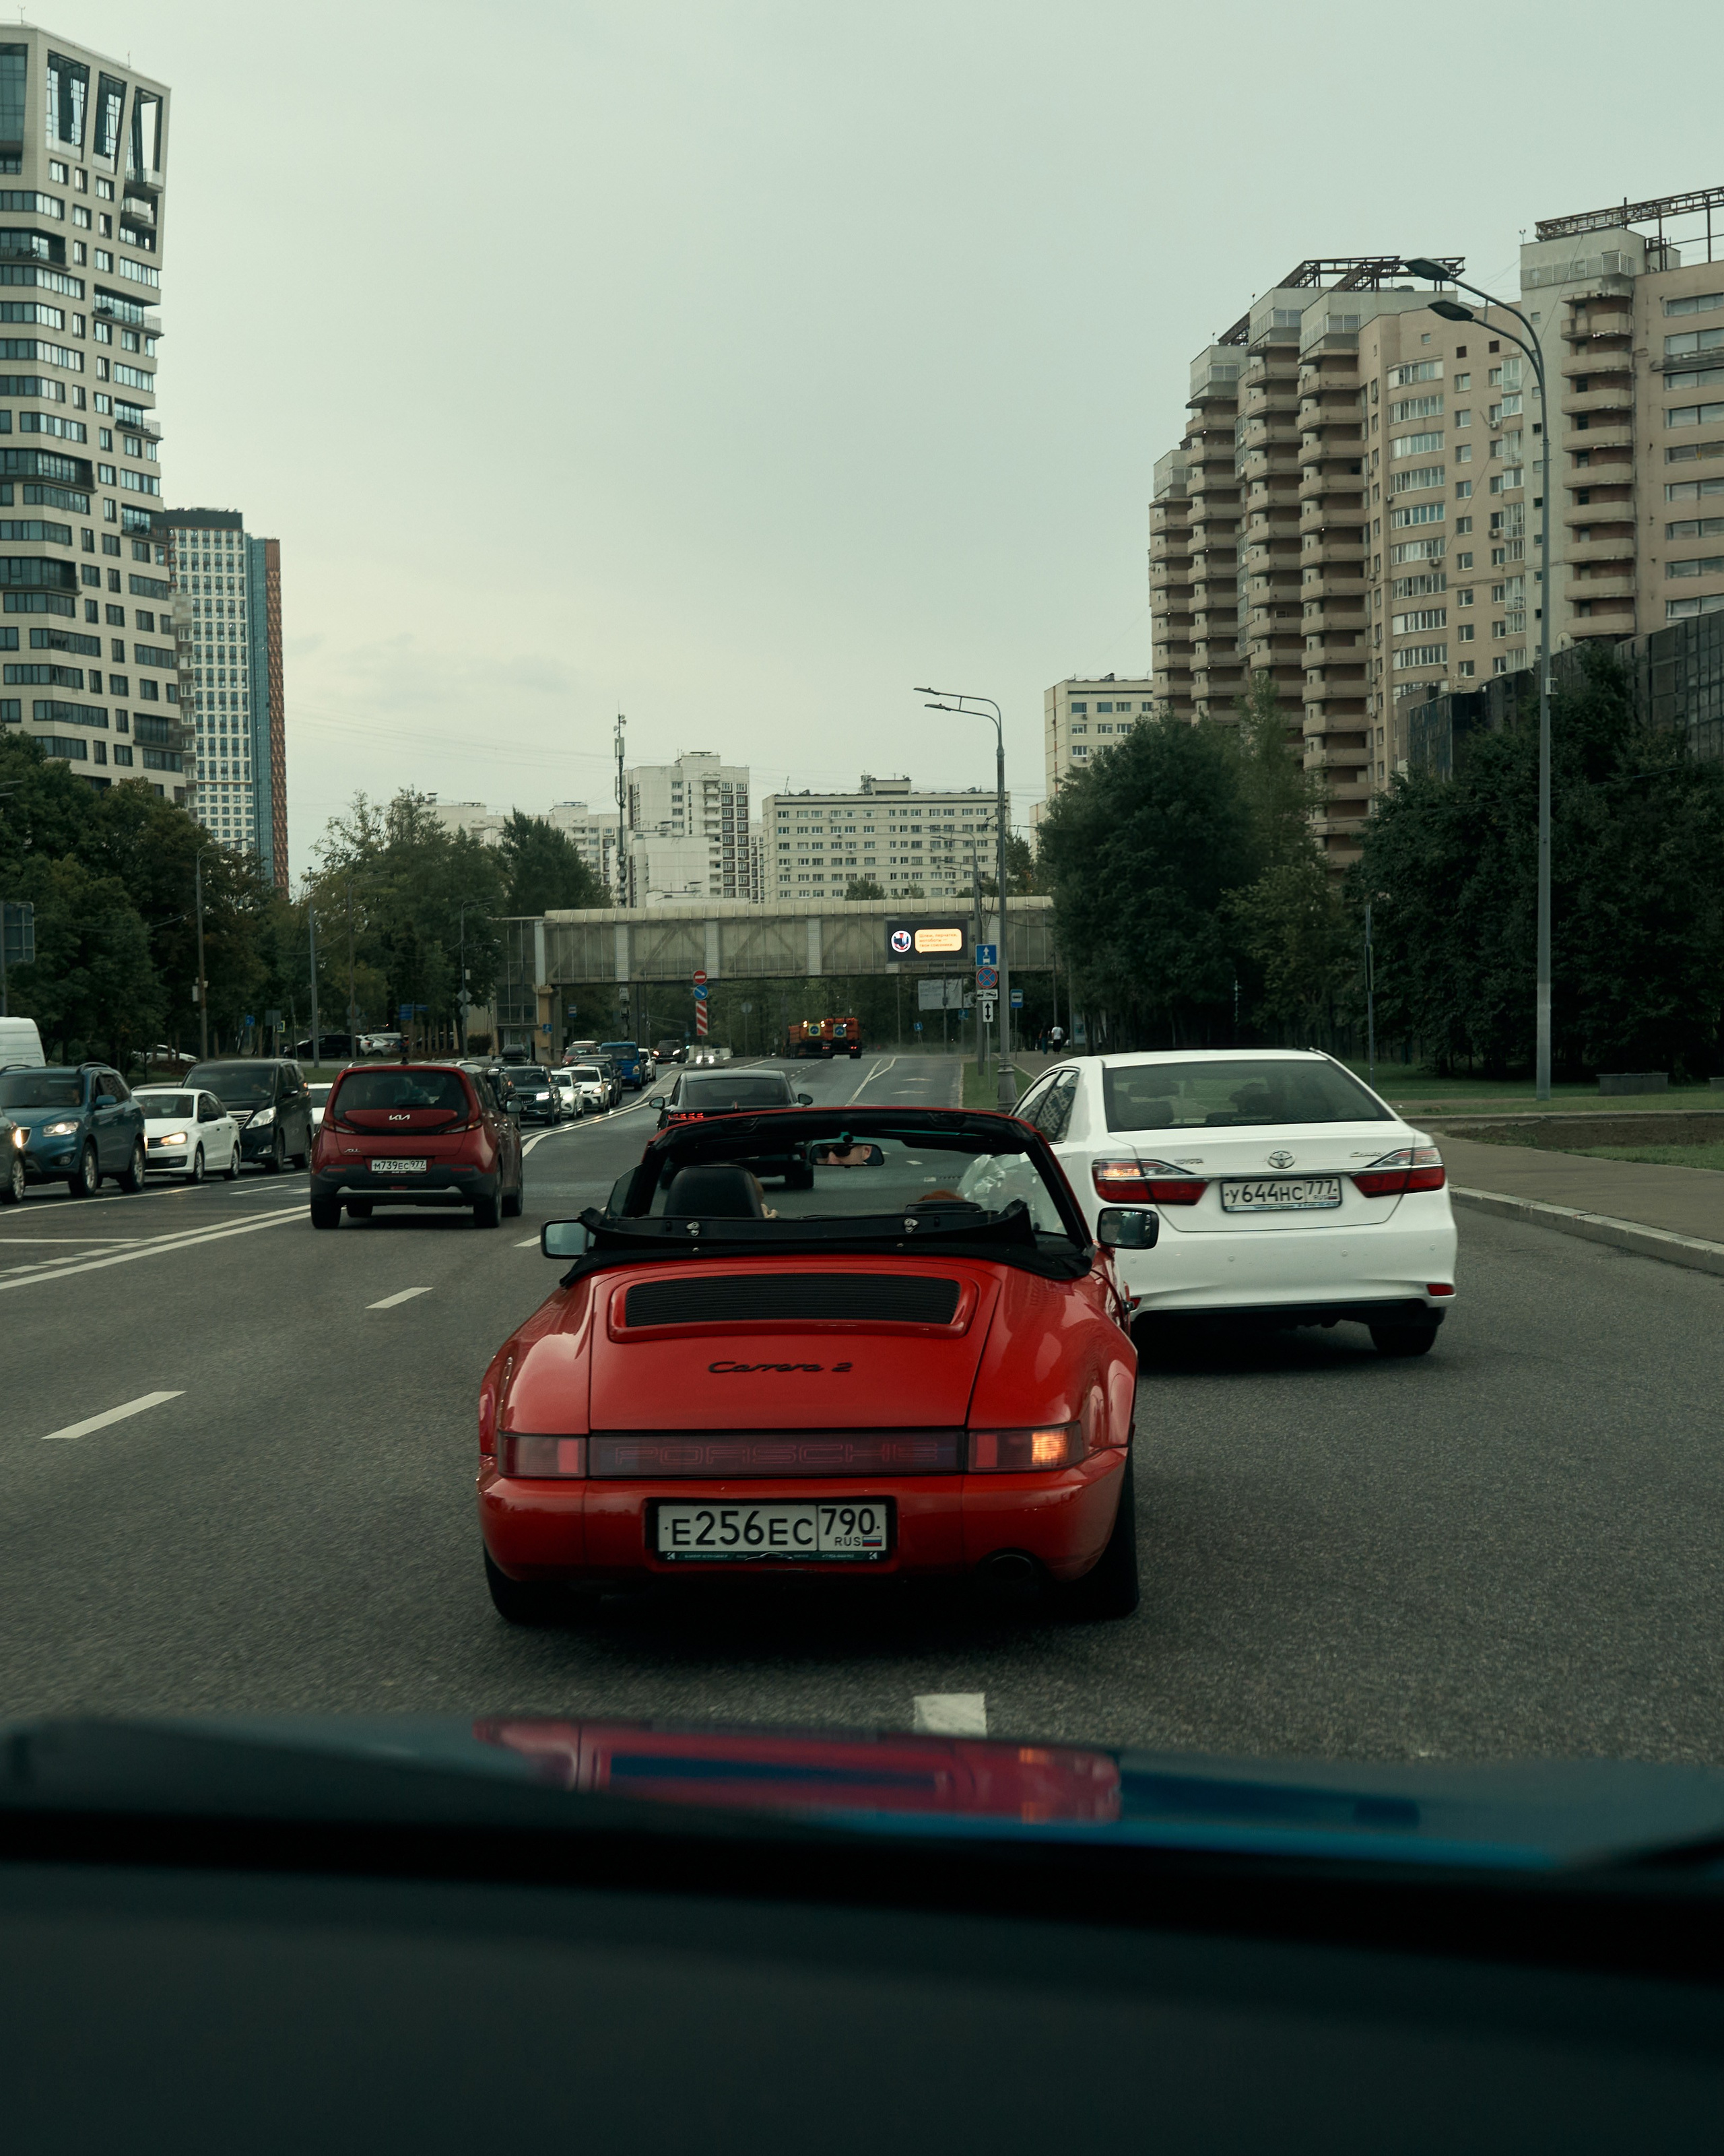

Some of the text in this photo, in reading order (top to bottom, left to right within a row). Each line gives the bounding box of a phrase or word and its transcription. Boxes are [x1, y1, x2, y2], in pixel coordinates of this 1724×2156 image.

[1306, 1180, 1333, 1196] 777
[708, 1361, 853, 1373] Carrera 2
[614, 1442, 938, 1466] PORSCHE
[820, 1507, 875, 1536] 790
[834, 1536, 861, 1546] RUS
